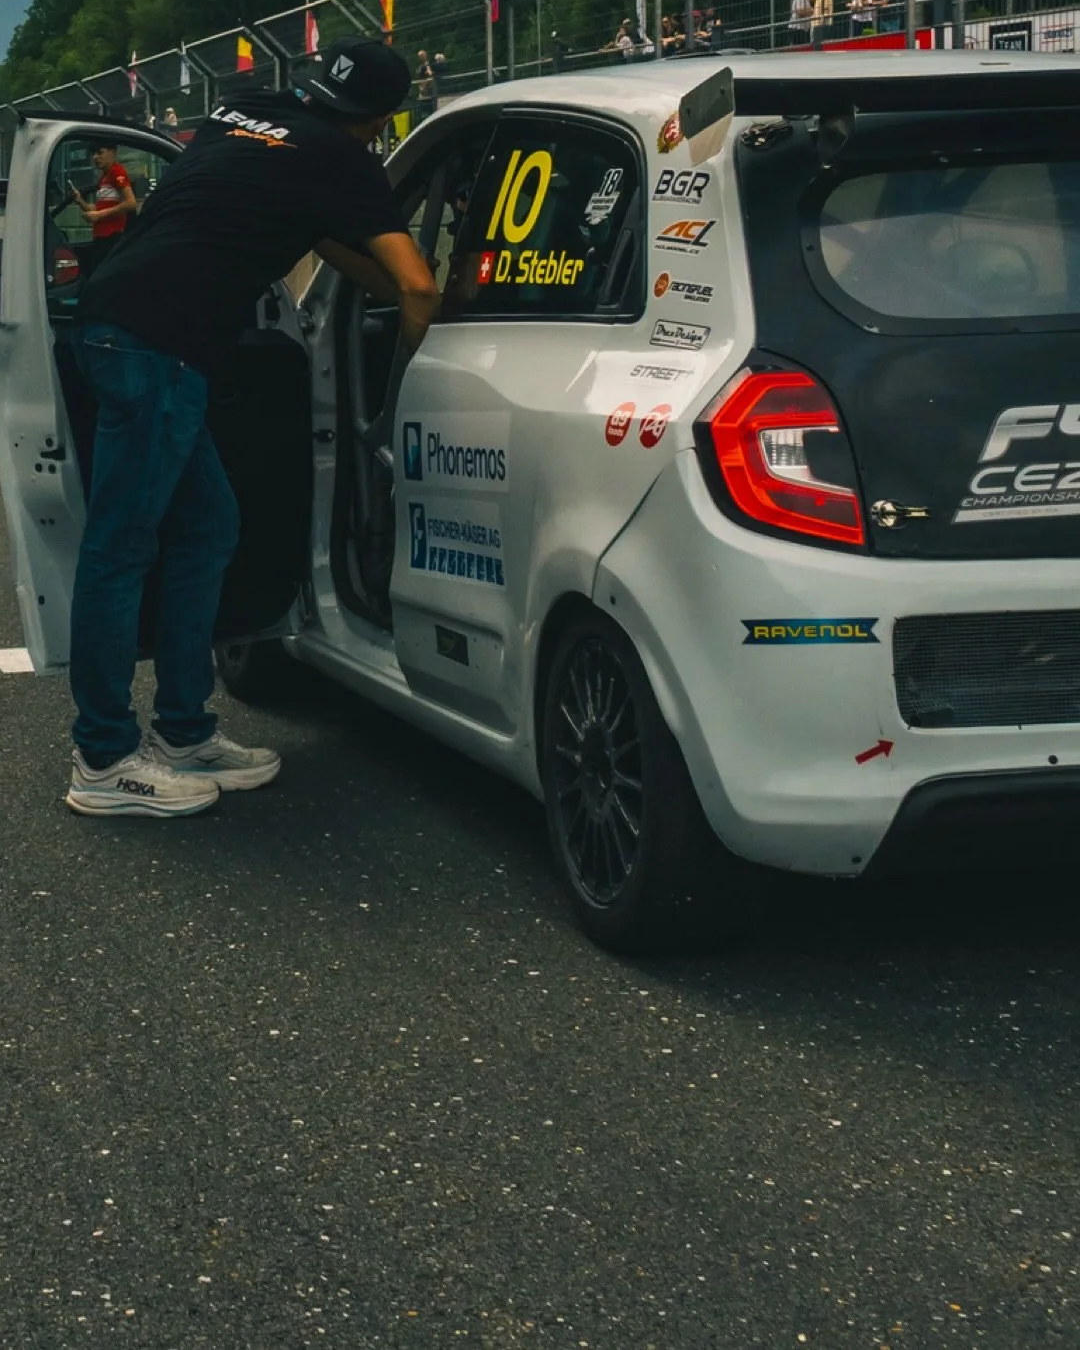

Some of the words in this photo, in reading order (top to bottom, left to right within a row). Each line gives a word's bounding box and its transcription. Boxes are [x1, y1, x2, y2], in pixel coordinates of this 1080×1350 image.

[210, 106, 290, 140] LEMA
[485, 149, 553, 244] 10
[654, 169, 711, 198] BGR
[495, 249, 512, 283] D.
[515, 249, 585, 285] Stebler
[427, 432, 506, 481] Phonemos
[753, 624, 868, 639] RAVENOL
[116, 777, 155, 797] HOKA
